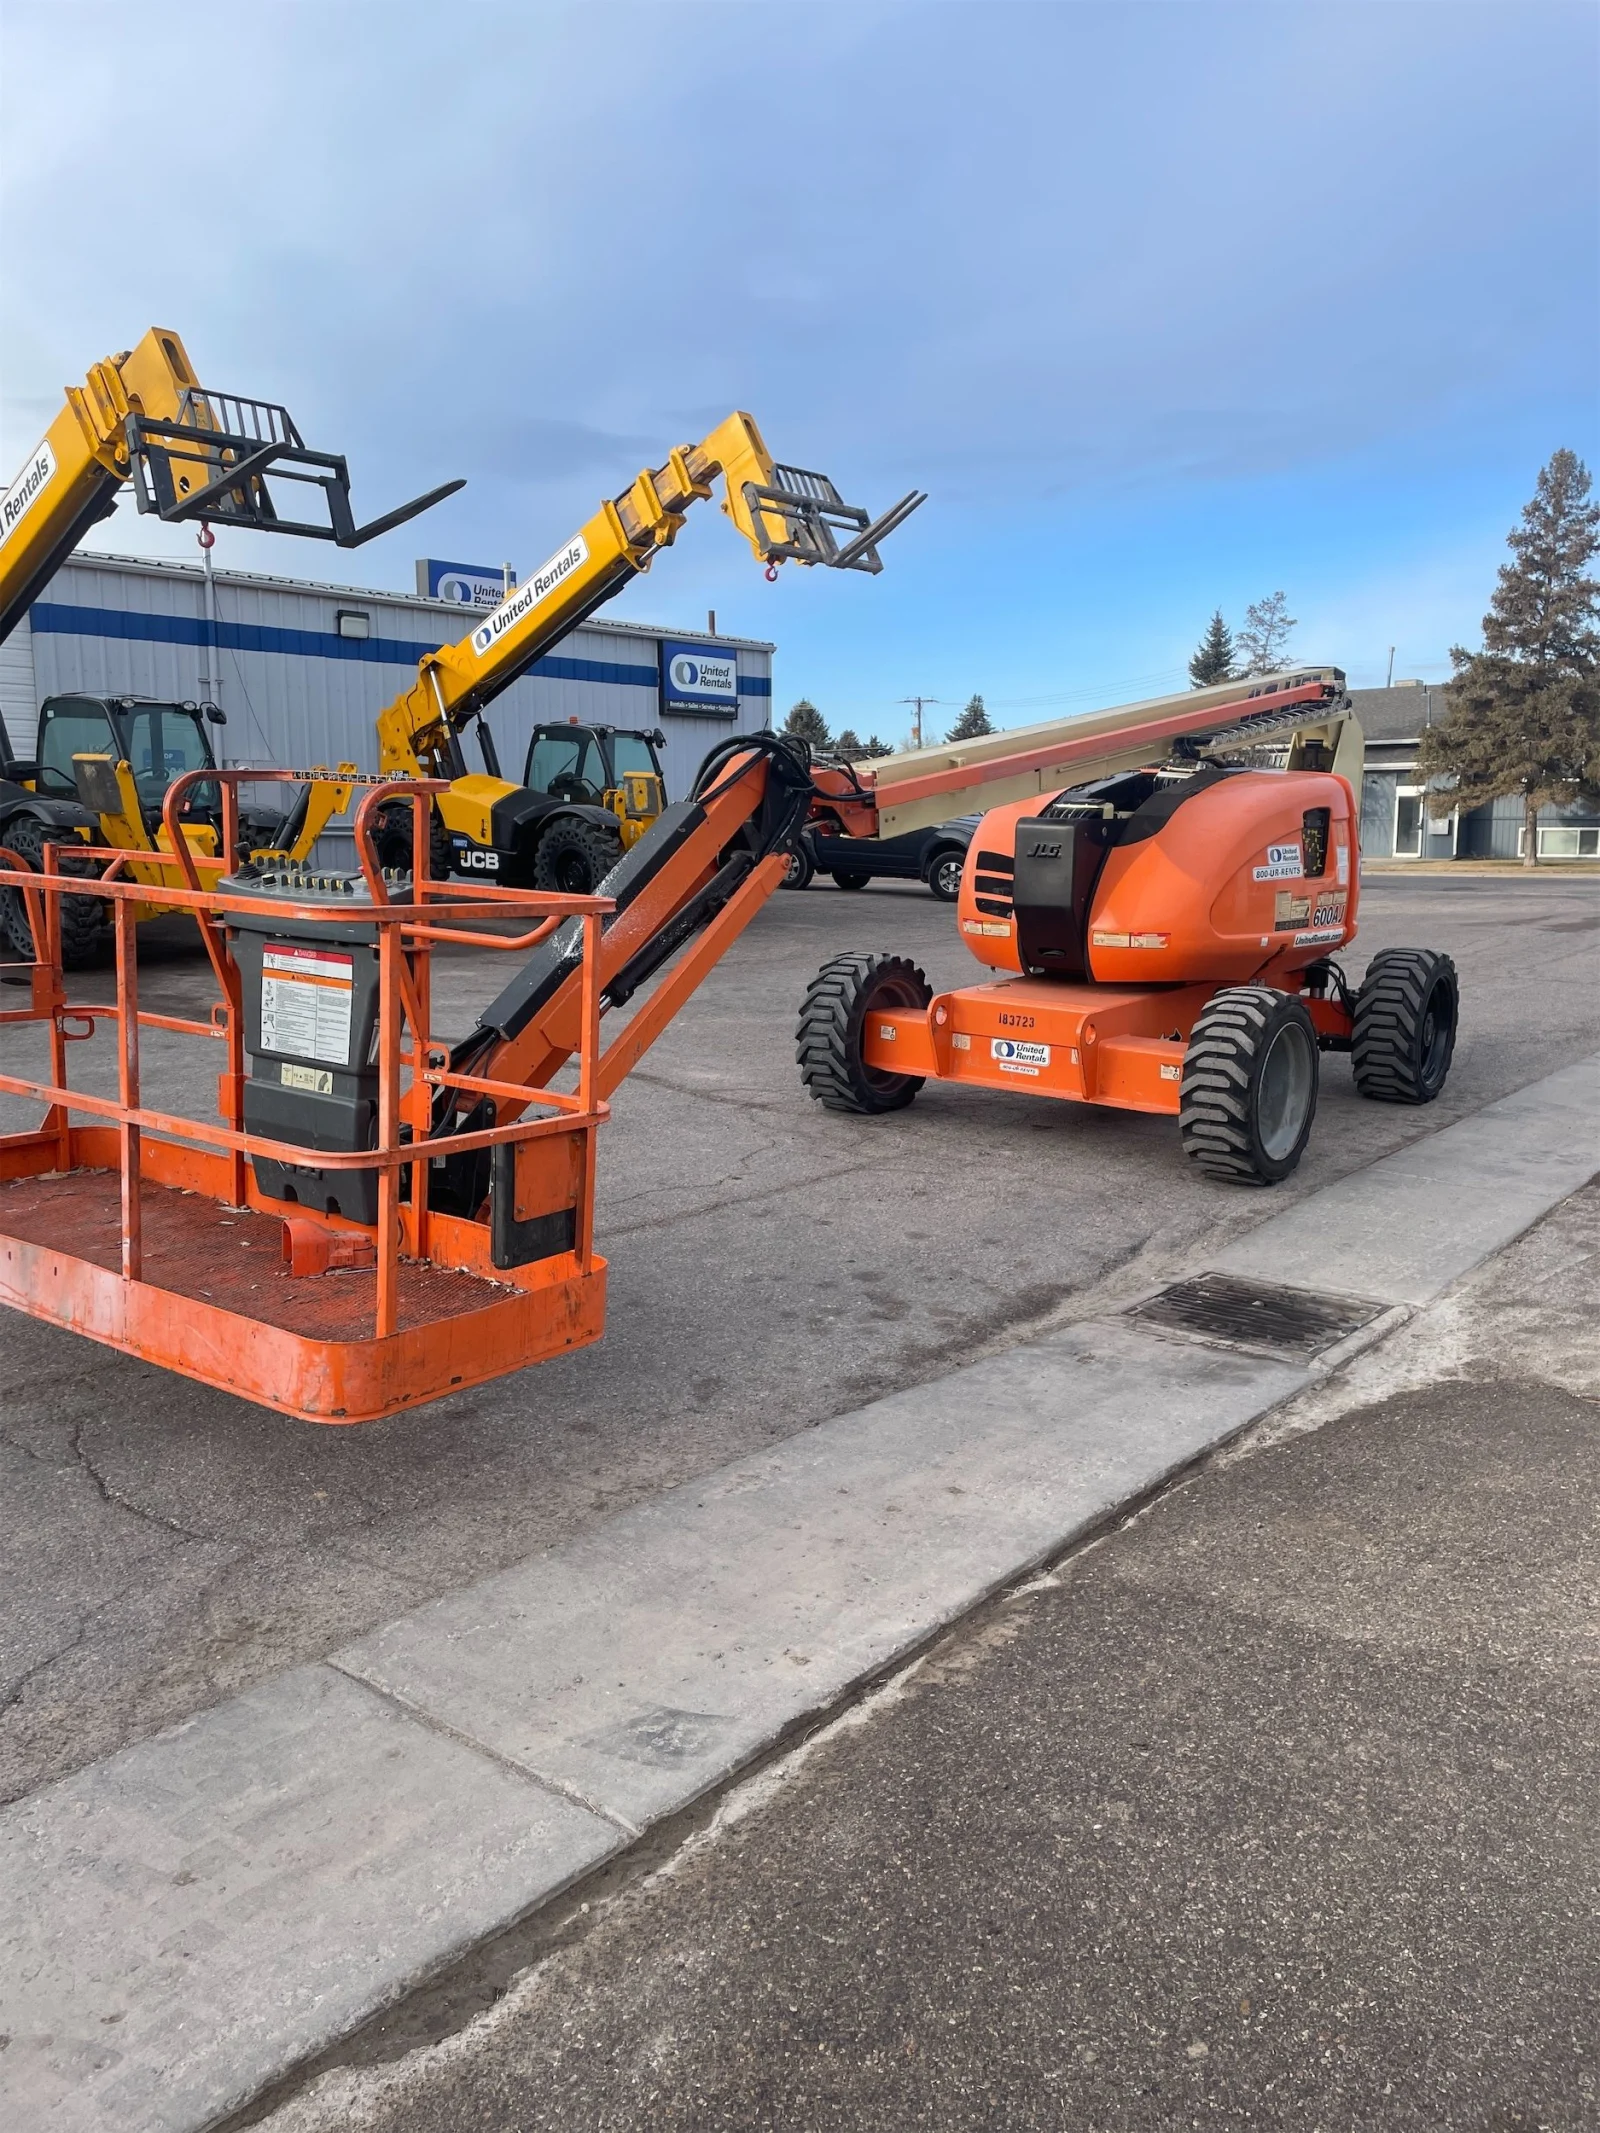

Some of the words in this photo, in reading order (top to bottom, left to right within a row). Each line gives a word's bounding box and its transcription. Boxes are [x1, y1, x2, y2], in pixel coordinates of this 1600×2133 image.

[4, 457, 49, 527] Rentals
[492, 587, 533, 634] United
[534, 546, 581, 597] Rentals
[700, 664, 730, 677] United
[700, 676, 732, 689] Rentals
[1026, 842, 1062, 859] JLG
[1281, 847, 1298, 855] United
[460, 850, 500, 870] JCB
[1255, 866, 1301, 879] 800-UR-RENTS
[1313, 904, 1346, 928] 600AJ
[998, 1012, 1036, 1029] 183723
[1016, 1043, 1045, 1055] United
[1015, 1051, 1047, 1063] Rentals
